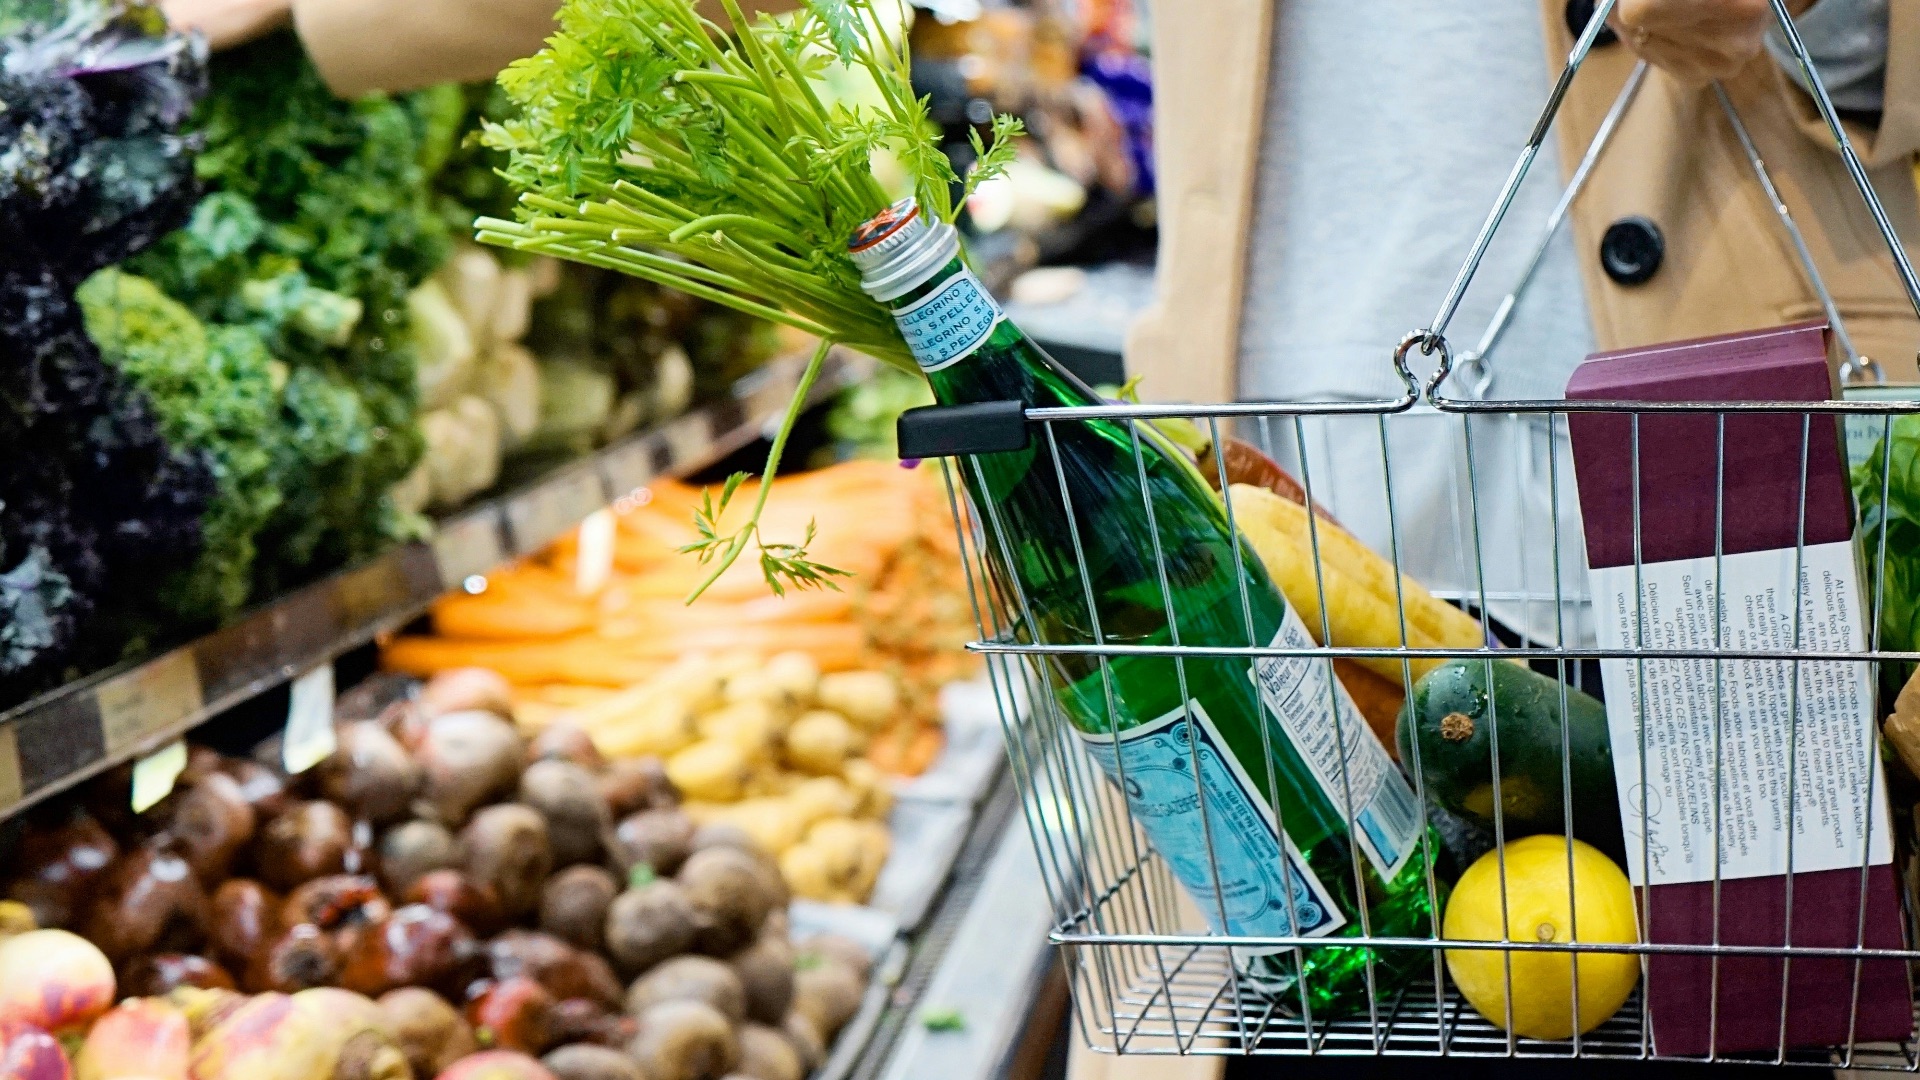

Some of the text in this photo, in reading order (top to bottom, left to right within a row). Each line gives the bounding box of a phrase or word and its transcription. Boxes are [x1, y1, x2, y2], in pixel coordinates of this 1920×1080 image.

[1682, 574, 1692, 595] Seul
[1704, 579, 1714, 591] de
[1822, 570, 1836, 611] delicious
[1834, 579, 1844, 589] At
[1648, 582, 1661, 625] Délicieux
[1685, 598, 1693, 610] un
[1695, 588, 1704, 610] avec
[1756, 594, 1766, 609] but
[1766, 587, 1777, 613] these
[1833, 591, 1848, 622] Lesley
[1684, 612, 1699, 645] produit
[1697, 613, 1709, 635] soin,
[1755, 611, 1769, 636] really
[1805, 609, 1816, 624] her
[1638, 600, 1656, 665] accompags
[1654, 627, 1662, 639] au
[1721, 626, 1732, 648] Stow
[1738, 629, 1749, 650] snac
[1767, 616, 1782, 648] unique
[1781, 623, 1793, 655] CRIS
[1808, 627, 1819, 650] team
[1818, 621, 1826, 637] are
[1617, 592, 1639, 712] vous ne pouz plus vous
[1701, 638, 1709, 649] en
[1762, 639, 1773, 663] she
[1820, 639, 1832, 665] me
[1831, 639, 1843, 668] The
[1259, 657, 1288, 684] Nutri
[1655, 642, 1668, 676] nurel,
[1691, 647, 1704, 681] aison
[1704, 658, 1715, 683] etites
[1649, 667, 1658, 679] de
[1680, 659, 1695, 692] pouvait
[1765, 666, 1776, 691] when
[1775, 658, 1787, 689] ackers
[1802, 667, 1814, 700] scratch
[1824, 668, 1835, 687] with
[1661, 679, 1669, 695] ces
[1729, 680, 1740, 708] Foods
[1815, 679, 1825, 693] the
[1835, 671, 1848, 709] fabulous
[1848, 680, 1859, 709] Foods
[1648, 681, 1665, 727] trempette,
[1694, 683, 1709, 720] fabriqué
[1746, 692, 1754, 706] are
[1766, 694, 1781, 726] topped
[1779, 692, 1788, 706] are
[1814, 696, 1827, 715] only
[1827, 690, 1836, 710] care
[1661, 698, 1678, 744] craquelins
[1664, 621, 1699, 824] CRAEZ POUR CES FINS CRAQUELINS
[1687, 695, 1701, 736] satisfaire
[1720, 700, 1733, 738] fabuleux
[1733, 711, 1744, 738] adore
[1744, 594, 1781, 832] cheese or apasto. We are addicted to this yummy
[1748, 710, 1757, 729] sure
[1779, 710, 1793, 734] great
[1804, 703, 1818, 728] using
[1830, 713, 1839, 721] in
[1852, 712, 1860, 725] we
[1657, 731, 1667, 742] de
[1701, 723, 1710, 745] avec
[1773, 728, 1784, 746] with
[1810, 730, 1818, 745] our
[1817, 718, 1828, 736] way
[1831, 724, 1843, 749] small
[1838, 712, 1852, 740] crisps
[1854, 728, 1864, 747] love
[1749, 732, 1760, 749] you
[1822, 739, 1832, 747] to
[1844, 742, 1855, 763] from
[1657, 745, 1672, 783] fromage
[1670, 747, 1681, 767] sont
[1690, 738, 1705, 768] Lesley
[1705, 748, 1715, 764] des
[1723, 741, 1740, 788] craquelins
[1734, 741, 1750, 781] fabriquer
[1754, 752, 1764, 766] will
[1773, 749, 1785, 769] your
[1812, 748, 1823, 773] finest
[1824, 750, 1835, 776] make
[1697, 770, 1706, 779] et
[1756, 769, 1766, 780] be
[1854, 750, 1869, 784] making
[1665, 785, 1672, 797] ou
[1673, 769, 1688, 820] irrésistibles
[1699, 782, 1707, 799] son
[1718, 768, 1731, 801] cuisine
[1742, 784, 1751, 793] et
[1845, 766, 1860, 803] Lesley's
[1723, 804, 1733, 815] de
[1732, 791, 1743, 811] sont
[1744, 796, 1753, 817] vous
[1826, 787, 1840, 811] great
[1747, 819, 1758, 840] offrir
[1796, 815, 1804, 834] own
[1829, 814, 1845, 848] product
[1853, 805, 1865, 839] kitchen
[1733, 813, 1749, 856] fabriqués
